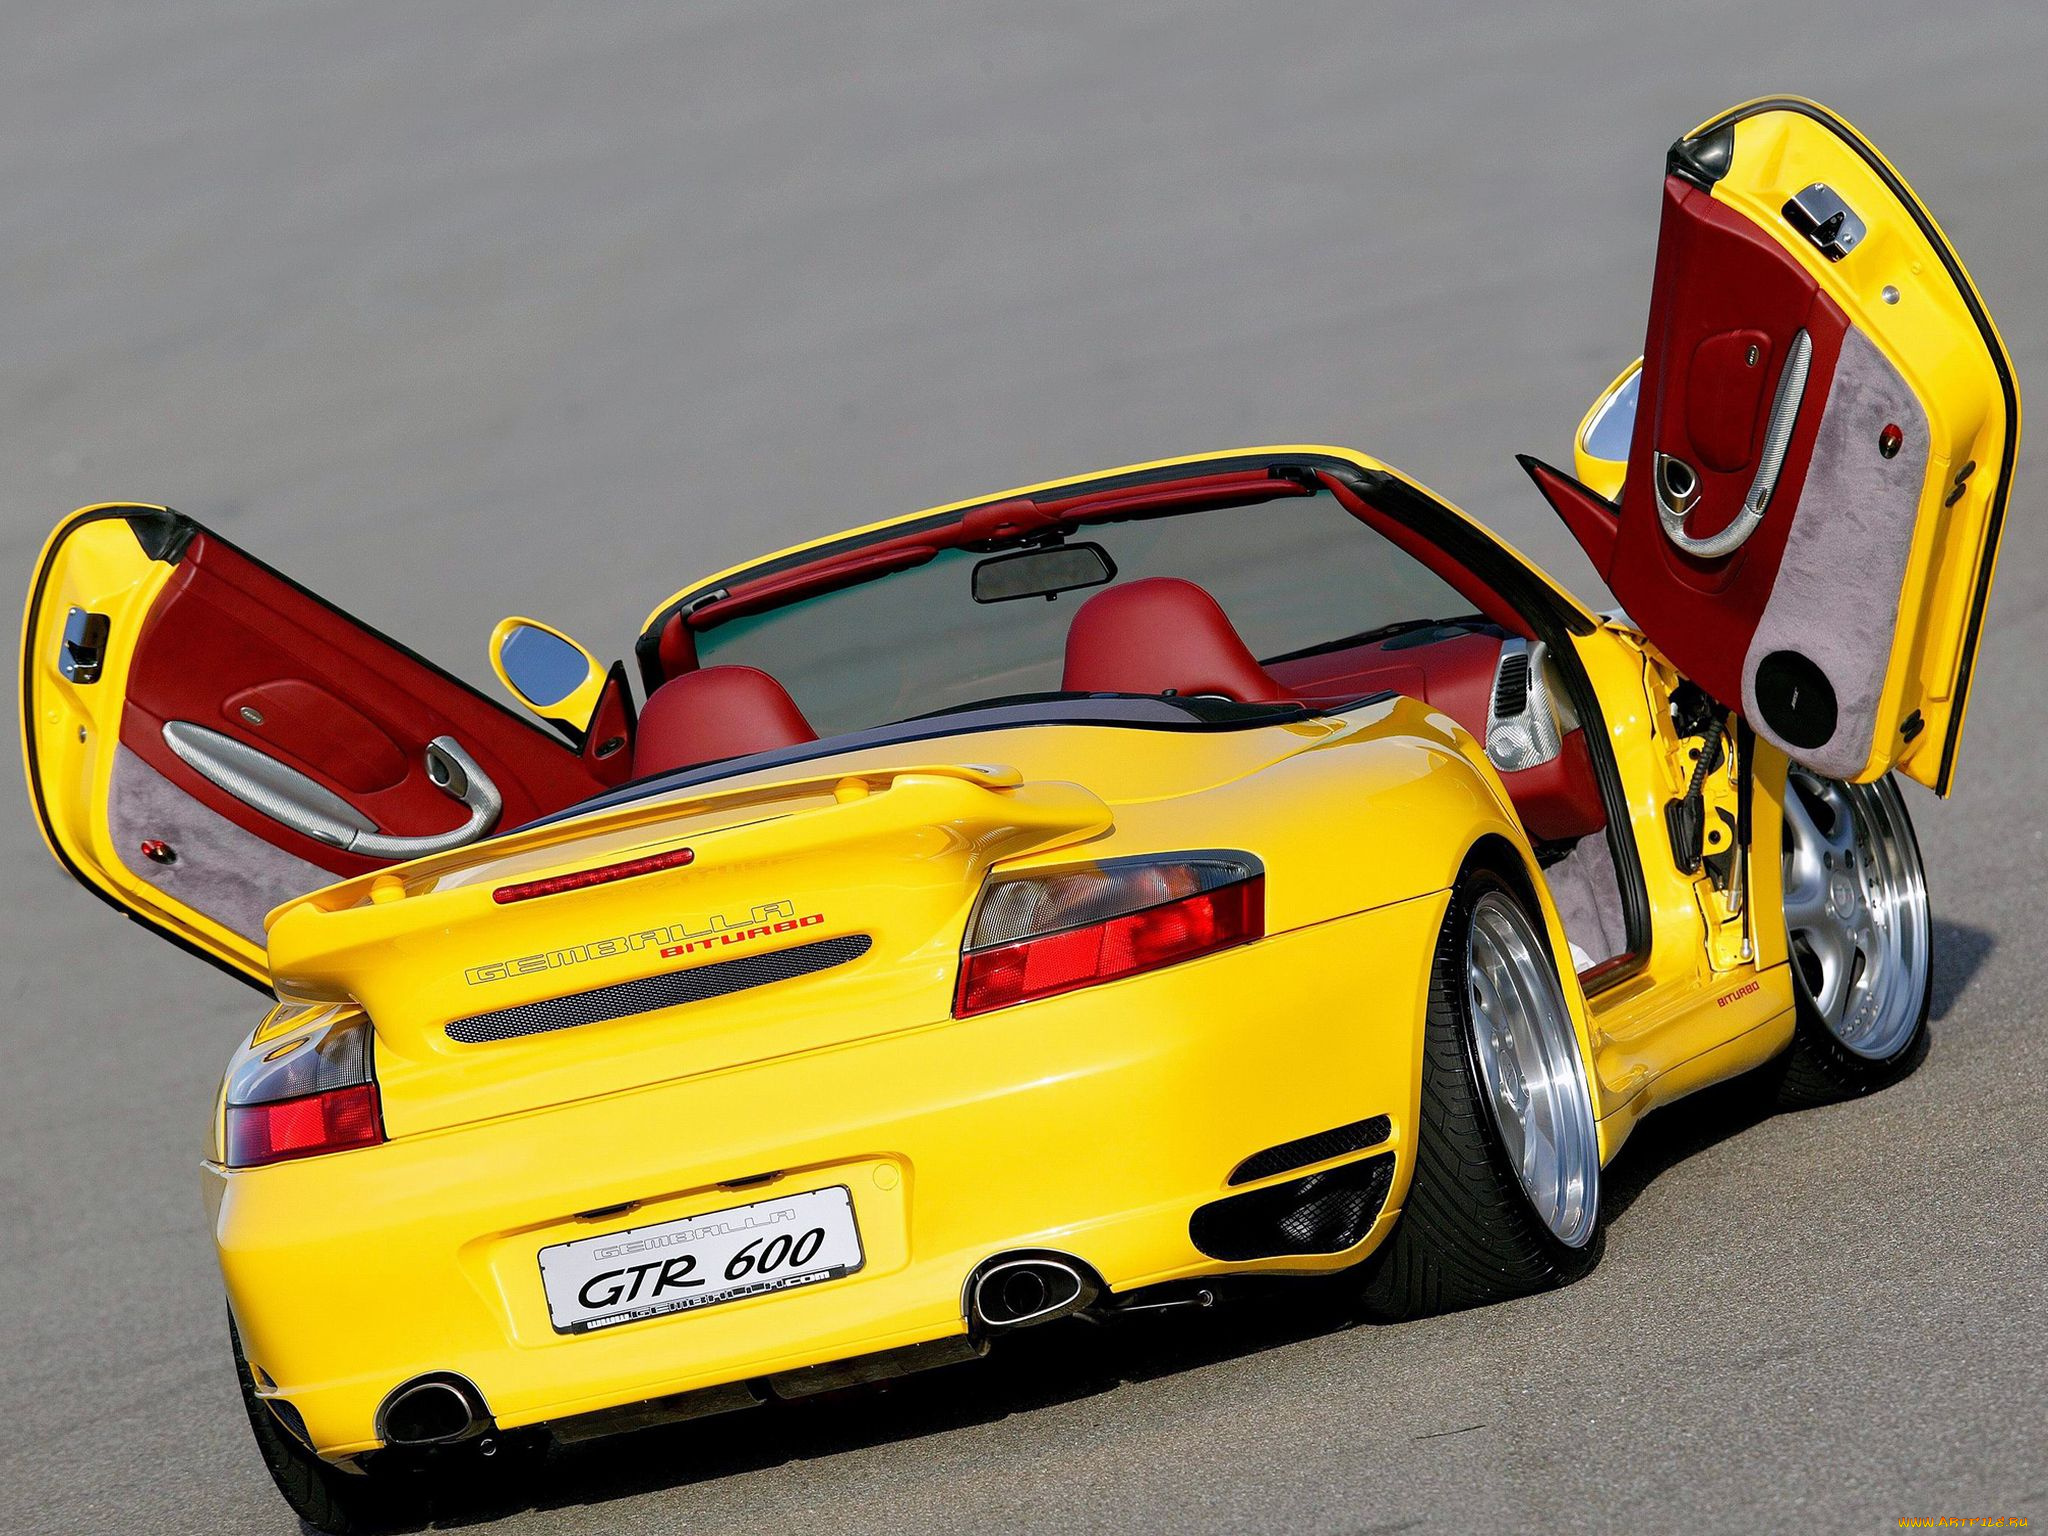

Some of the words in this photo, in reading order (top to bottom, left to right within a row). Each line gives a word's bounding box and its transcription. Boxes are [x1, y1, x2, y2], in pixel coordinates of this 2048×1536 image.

[465, 900, 795, 986] GEMBALLA
[660, 913, 825, 959] BITURBO
[1717, 980, 1760, 1008] BITURBO
[592, 1208, 797, 1261] GEMBALLA
[577, 1254, 706, 1309] GTR
[723, 1227, 826, 1281] 600
